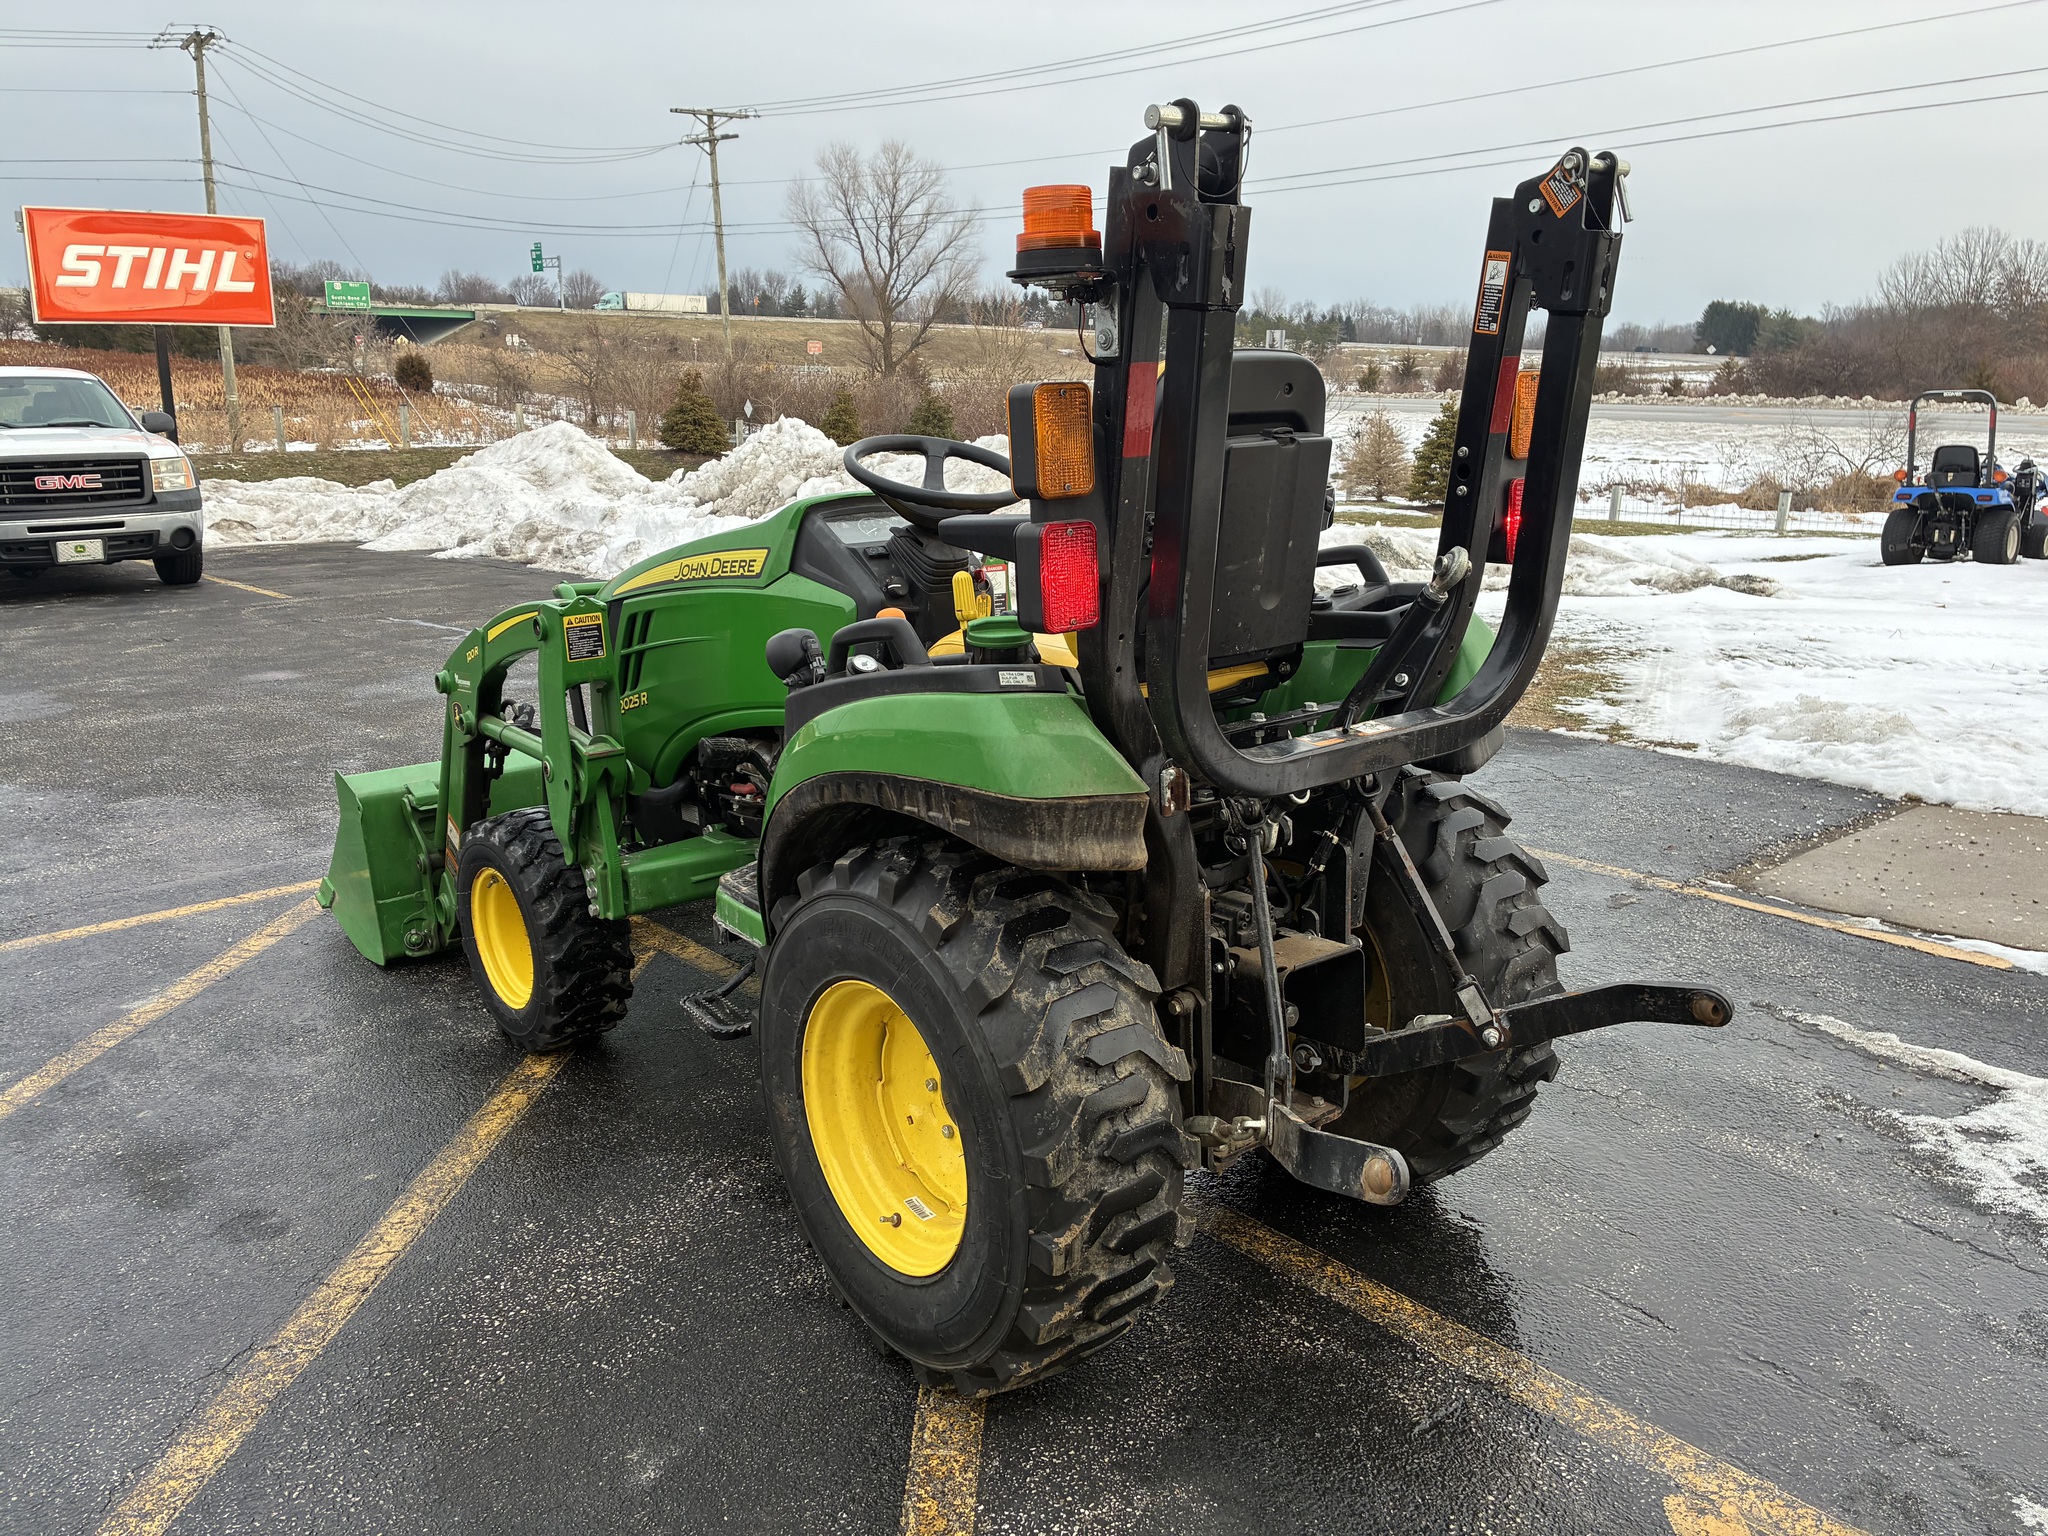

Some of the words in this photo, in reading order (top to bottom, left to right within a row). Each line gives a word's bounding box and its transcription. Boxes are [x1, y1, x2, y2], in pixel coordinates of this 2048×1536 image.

[55, 244, 255, 292] STIHL
[35, 474, 103, 490] GMC
[674, 562, 709, 579] JOHN
[711, 558, 757, 574] DEERE
[574, 614, 601, 624] CAUTION
